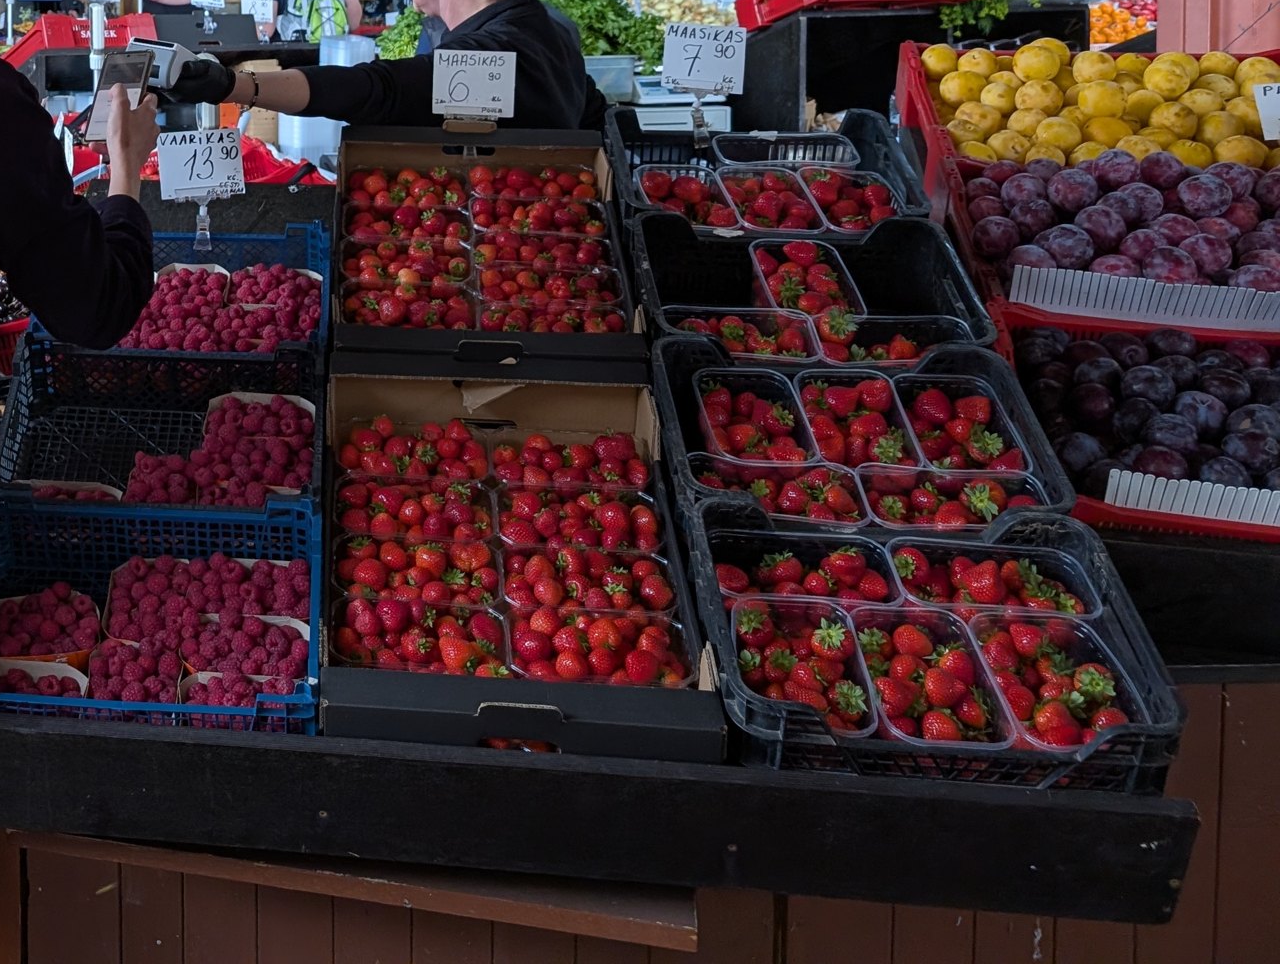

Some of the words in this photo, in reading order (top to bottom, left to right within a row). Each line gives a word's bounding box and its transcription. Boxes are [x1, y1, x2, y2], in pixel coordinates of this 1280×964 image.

[713, 43, 736, 59] 90
[488, 72, 501, 81] 90
[219, 145, 239, 160] 90
